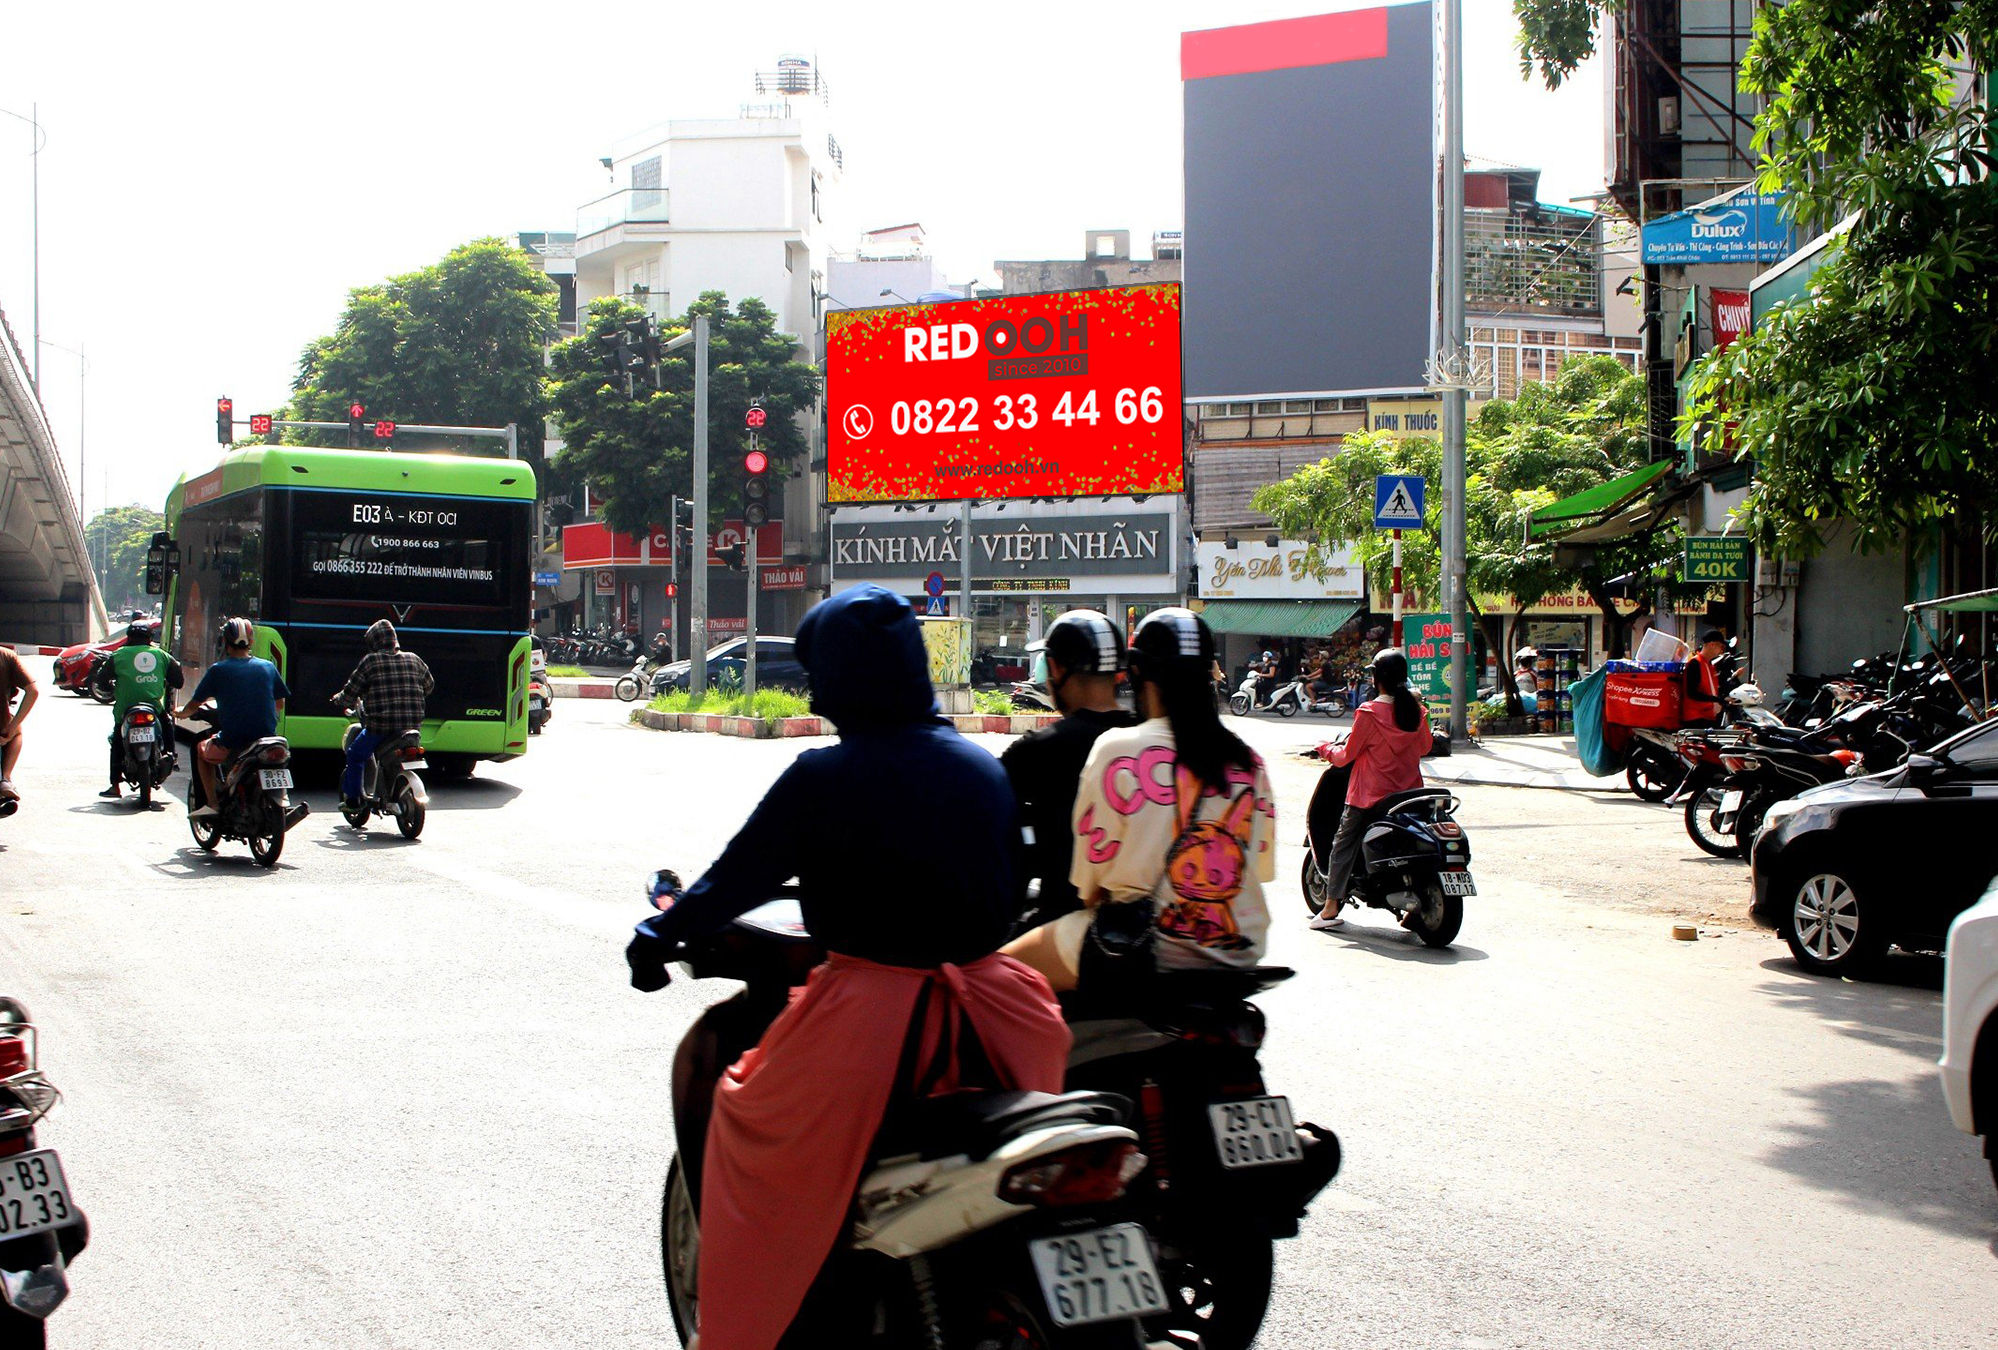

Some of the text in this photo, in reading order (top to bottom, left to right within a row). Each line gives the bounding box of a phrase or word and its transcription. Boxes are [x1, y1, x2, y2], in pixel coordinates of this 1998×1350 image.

[1691, 223, 1740, 238] Dulux
[904, 313, 1089, 363] RED OOH
[994, 357, 1081, 377] since 2010
[891, 386, 1163, 436] 0822 33 44 66
[1374, 409, 1438, 431] KÍNH THUỐC
[252, 418, 269, 431] 22
[375, 422, 394, 437] 22
[934, 460, 1060, 478] www.redooh.vn
[353, 504, 381, 523] E03
[408, 510, 434, 524] KĐT
[378, 538, 440, 549] 1900 866 663
[835, 526, 907, 564] KÍNH
[978, 524, 1055, 569] VIỆT
[1058, 521, 1159, 560] NHÃN
[313, 561, 326, 574] GỌI
[327, 560, 349, 572] 0866
[349, 560, 366, 573] 355
[367, 562, 383, 574] 222
[395, 563, 408, 576] TRỞ
[408, 564, 432, 577] THÀNH
[452, 567, 468, 579] VIÊN
[468, 569, 493, 580] VINBUS
[764, 567, 804, 583] THẢO VẢI
[1694, 562, 1737, 577] 40K
[1422, 620, 1452, 639] BÚN
[1409, 638, 1435, 659] HẢI
[135, 674, 158, 683] Grab
[1411, 672, 1431, 681] TÔM
[1606, 681, 1633, 693] Shopee
[465, 708, 503, 716] GREEN
[1222, 1101, 1284, 1132] 29-C1
[1053, 1270, 1160, 1320] 677.18
